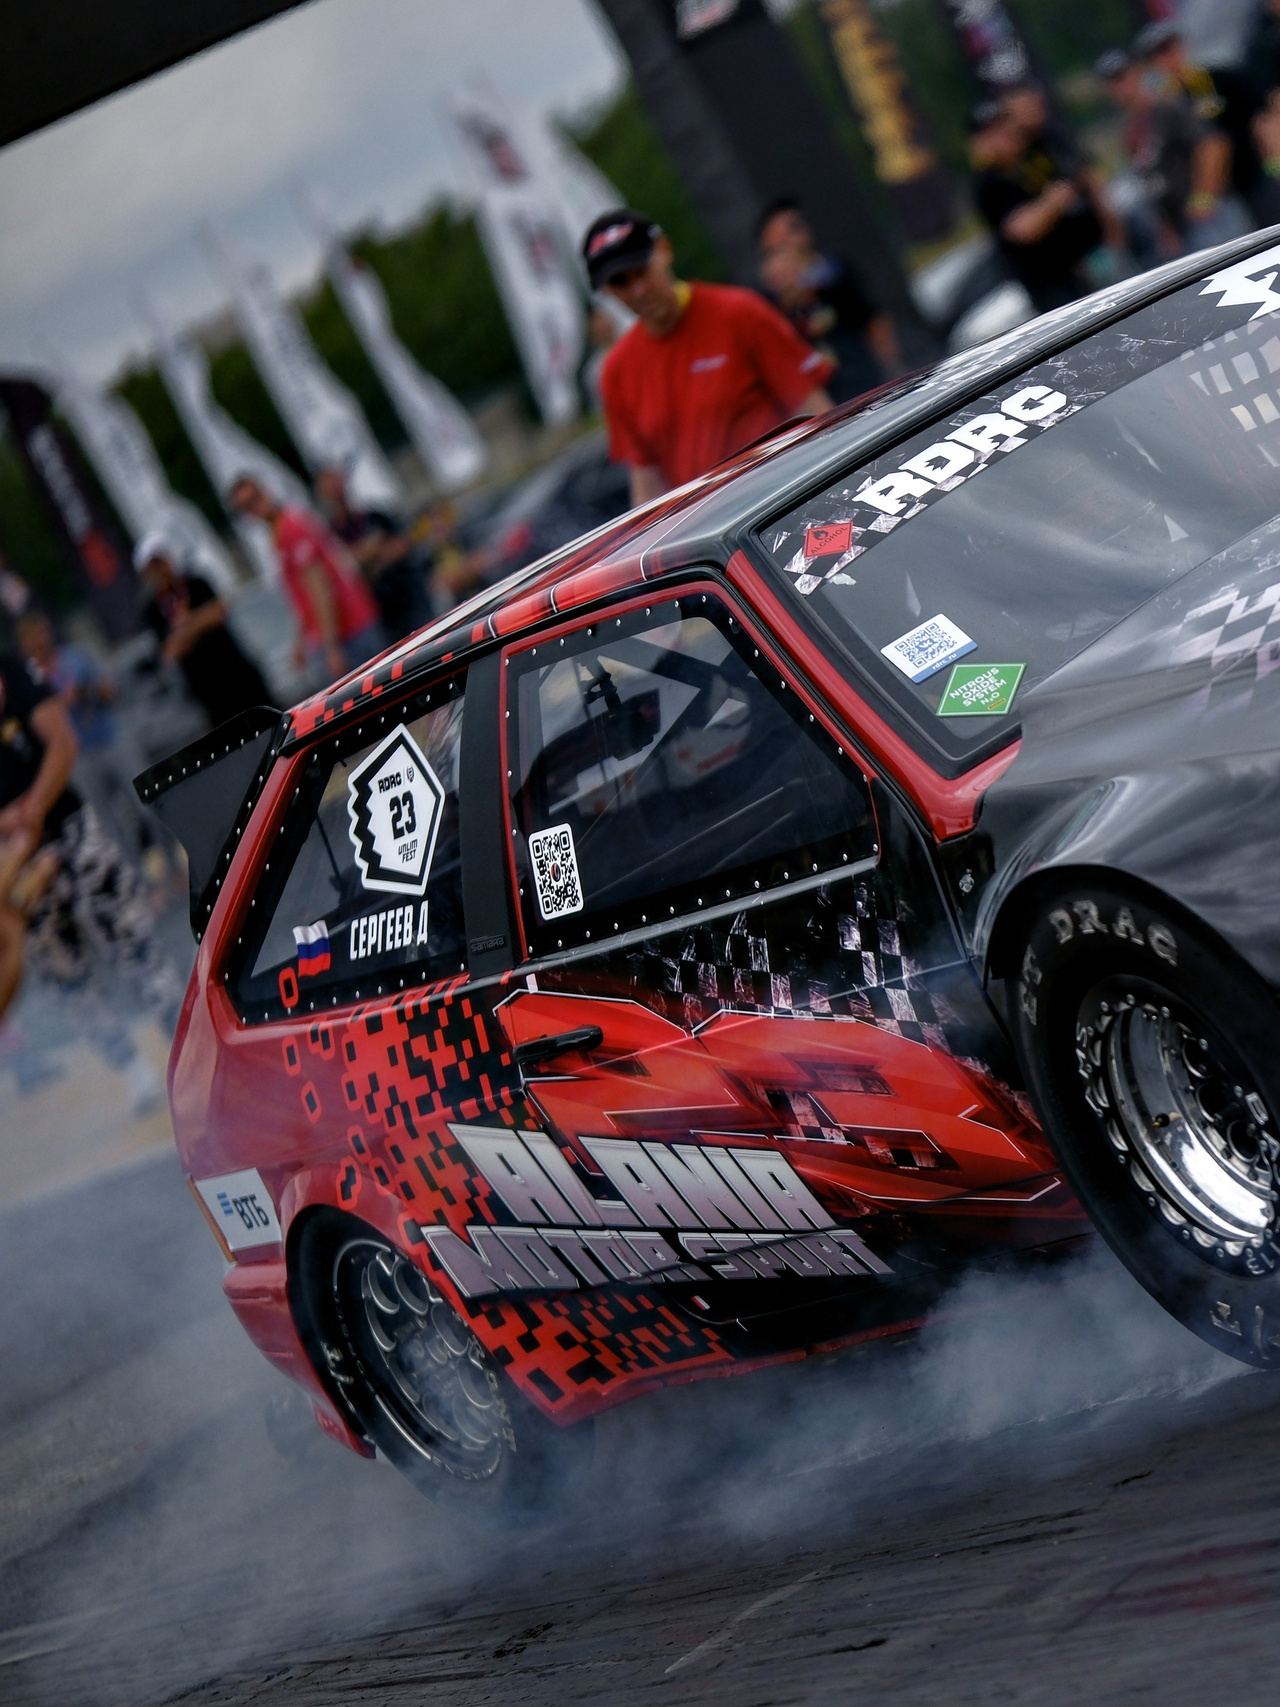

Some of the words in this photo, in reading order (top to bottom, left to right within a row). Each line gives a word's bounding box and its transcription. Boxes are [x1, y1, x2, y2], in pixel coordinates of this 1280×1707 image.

[851, 385, 1067, 515] RDRC
[811, 527, 848, 554] ALCOHOL
[949, 667, 999, 698] NITROUS
[962, 676, 997, 699] OXIDE
[962, 678, 1007, 706] SYSTEM
[389, 790, 417, 840] 23
[402, 848, 417, 864] FEST
[350, 904, 414, 961] СЕРГЕЕВ
[416, 900, 429, 946] Д
[1048, 899, 1179, 968] DRAG
[446, 1122, 839, 1230] ALANIA
[231, 1193, 270, 1231] ВТБ
[420, 1225, 713, 1299] MOTOR
